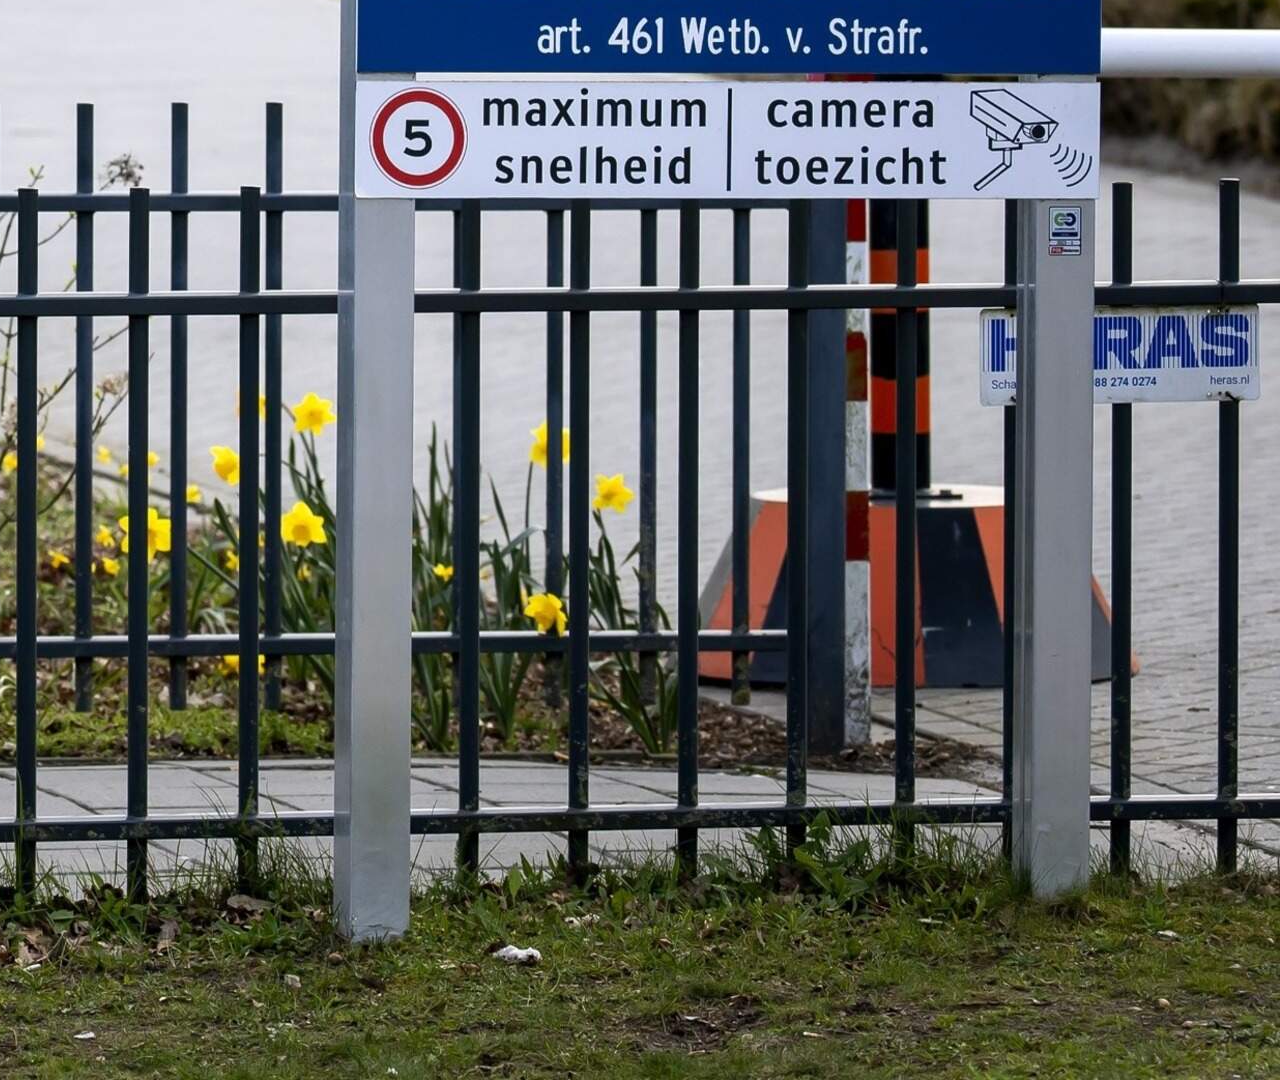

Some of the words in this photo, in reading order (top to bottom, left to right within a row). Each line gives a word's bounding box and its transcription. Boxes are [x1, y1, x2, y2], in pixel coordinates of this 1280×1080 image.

[537, 17, 591, 55] art.
[608, 16, 664, 55] 461
[680, 16, 770, 55] Wetb.
[785, 27, 811, 54] v.
[828, 17, 928, 55] Strafr.
[483, 87, 707, 127] maximum
[767, 99, 934, 128] camera
[403, 119, 433, 158] 5
[494, 145, 691, 185] snelheid
[754, 145, 947, 185] toezicht
[990, 313, 1250, 372] HRAS
[1110, 376, 1129, 387] 274
[1131, 376, 1158, 387] 0274
[1209, 374, 1251, 386] heras.nl
